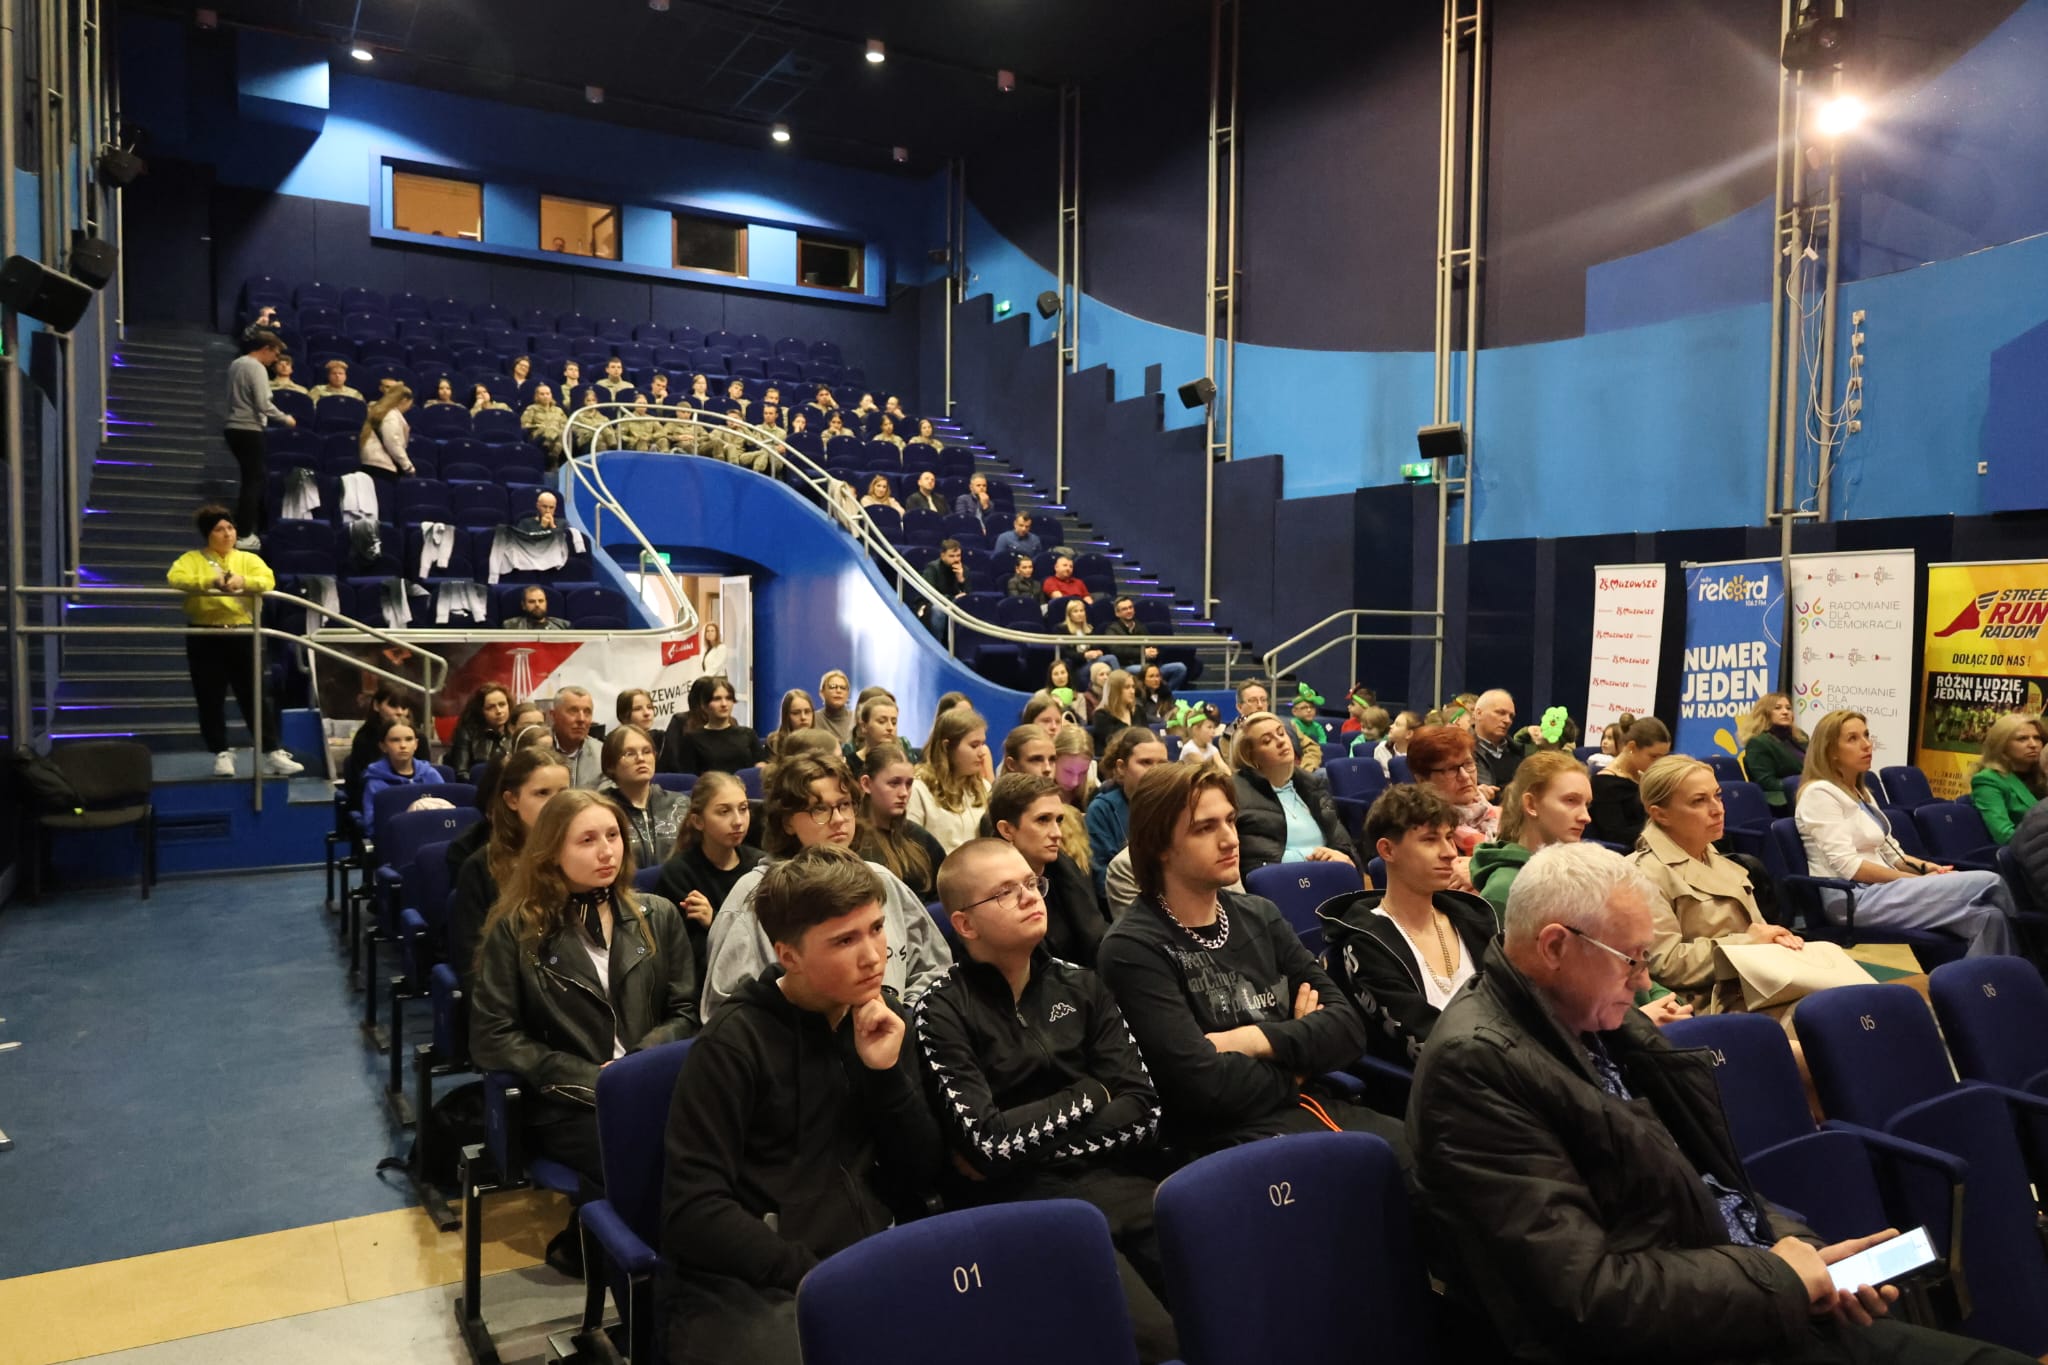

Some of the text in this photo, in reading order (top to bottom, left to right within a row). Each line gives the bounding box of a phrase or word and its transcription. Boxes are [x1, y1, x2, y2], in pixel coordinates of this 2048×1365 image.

[1698, 574, 1769, 602] rekord
[2000, 588, 2048, 601] STREE
[1829, 600, 1902, 610] RADOMIANIE
[1987, 601, 2048, 625] RUN
[1829, 610, 1850, 619] DLA
[1828, 620, 1902, 630] DEMOKRACJI
[1980, 624, 2041, 639] RADOM
[1683, 641, 1768, 672] NUMER
[1952, 653, 1989, 667] DOŁĄCZ
[1990, 654, 2004, 666] DO
[2006, 655, 2026, 666] NAS
[1681, 668, 1768, 702] JEDEN
[1827, 684, 1897, 697] RADOMIANIE
[1936, 673, 2025, 694] RÓŻNI LUDZIE,
[1827, 693, 1848, 703] DLA
[1934, 688, 1972, 700] JEDNA
[1974, 689, 2014, 704] PASJA
[653, 701, 676, 717] OWE
[1681, 701, 1755, 719] W RADOM
[444, 819, 456, 828] 01
[1298, 877, 1311, 889] 05
[1982, 982, 1997, 998] 06
[1859, 1014, 1876, 1031] 05
[1269, 1181, 1296, 1207] 02
[953, 1262, 982, 1293] 01
